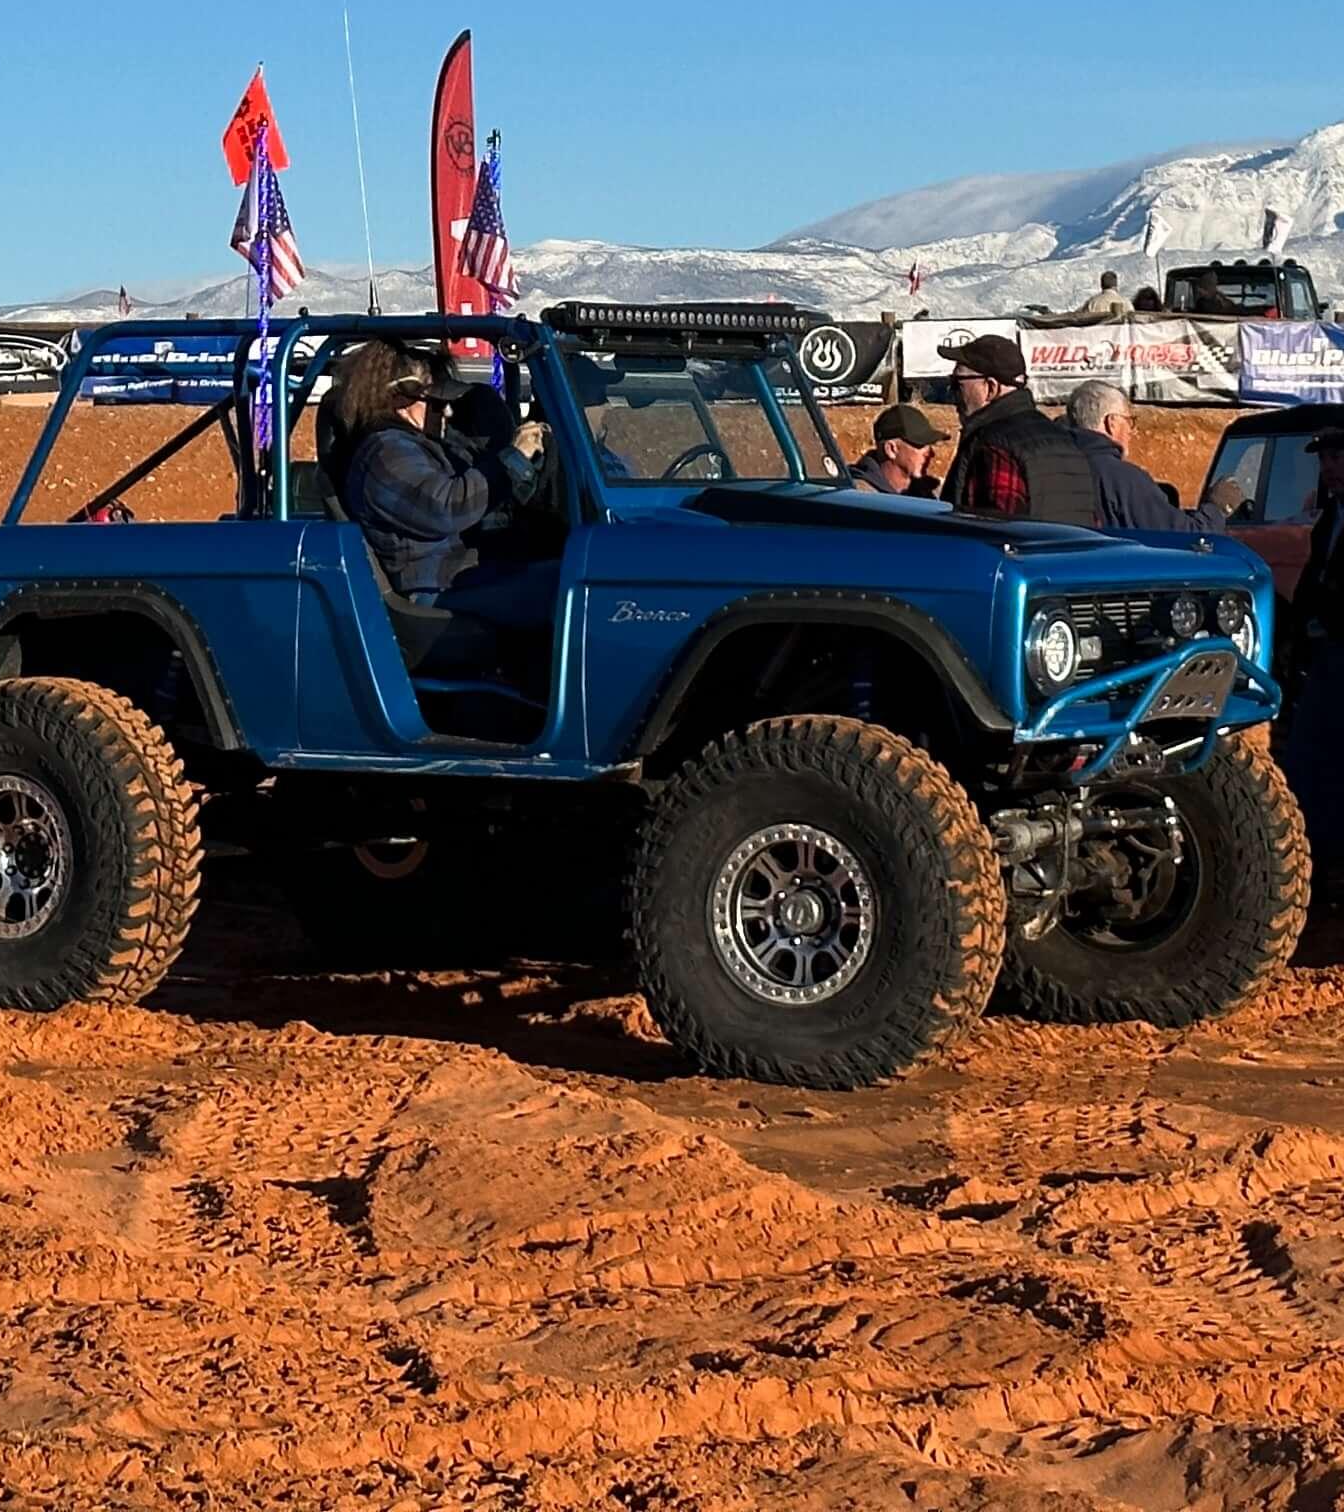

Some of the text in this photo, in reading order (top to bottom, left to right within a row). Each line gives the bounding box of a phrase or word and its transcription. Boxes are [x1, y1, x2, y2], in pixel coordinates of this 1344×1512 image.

[1030, 344, 1089, 364] WILD
[1251, 348, 1316, 366] Blue
[607, 600, 691, 622] Bronco
